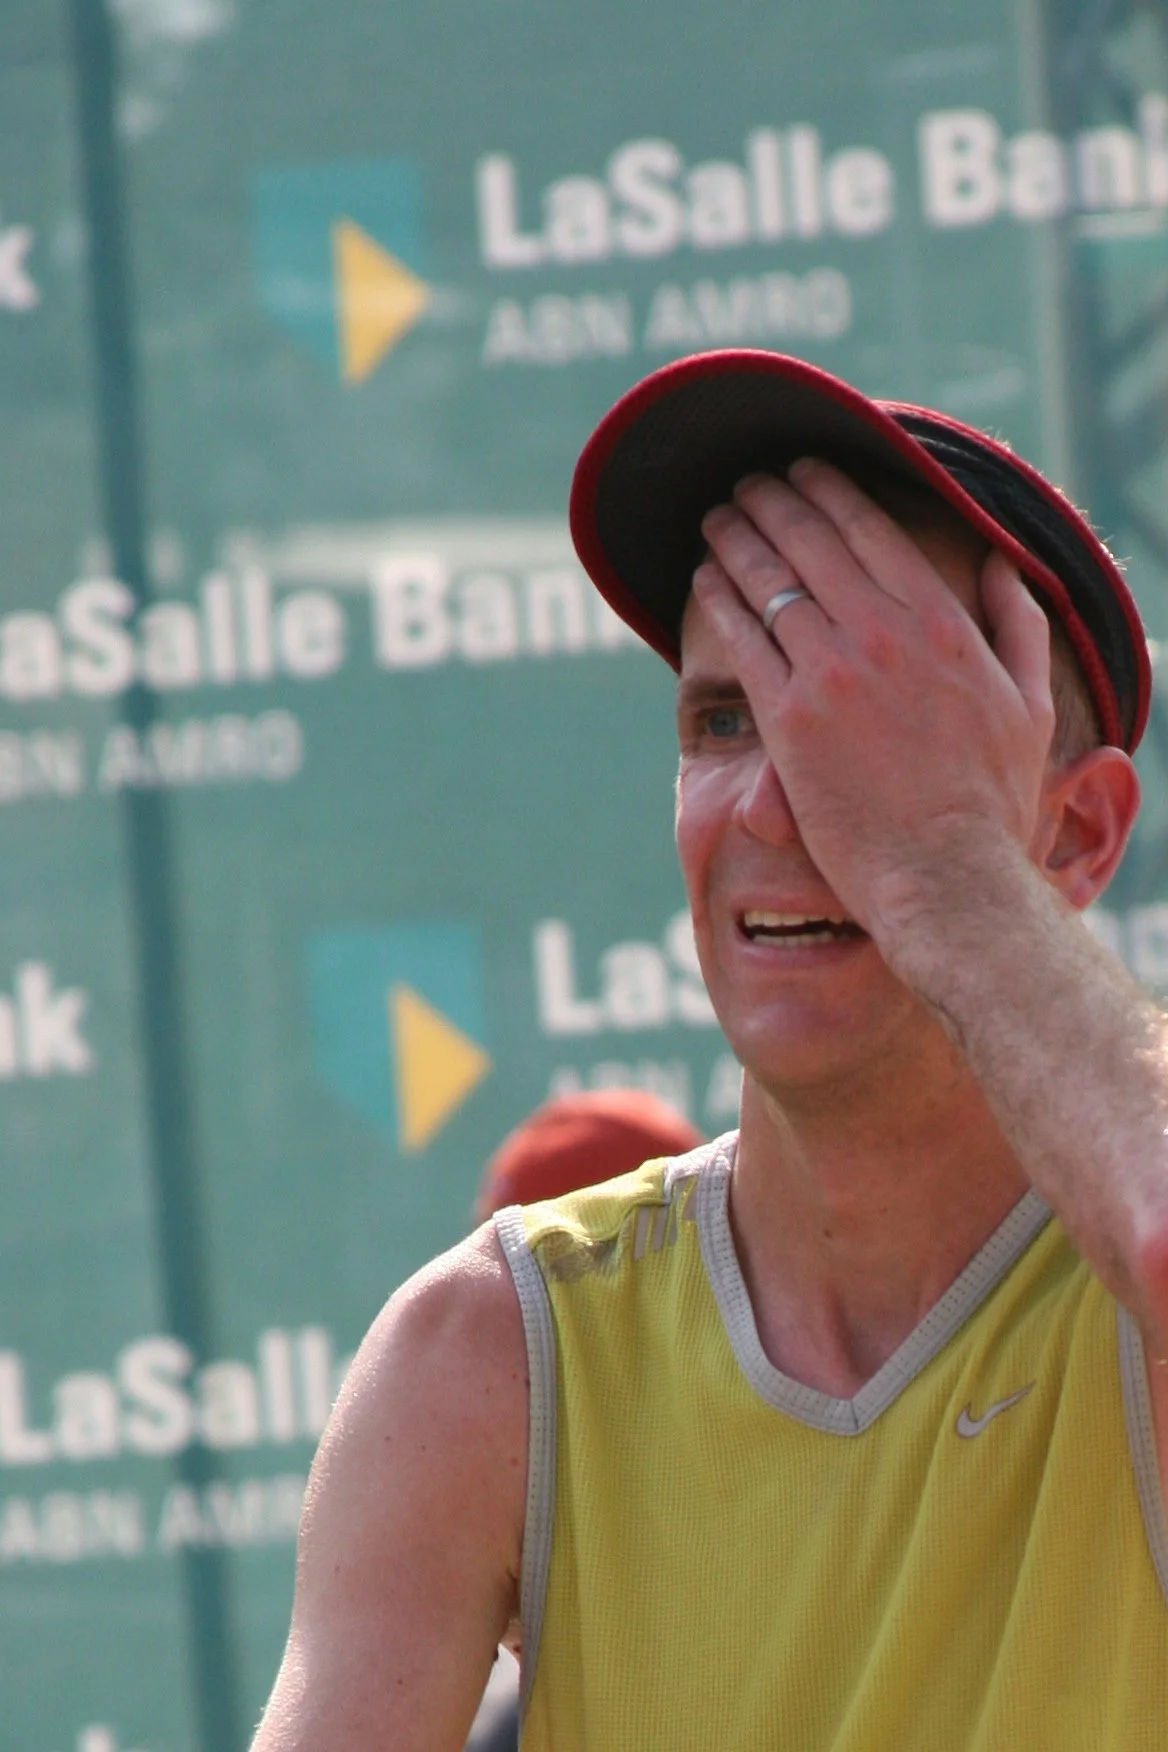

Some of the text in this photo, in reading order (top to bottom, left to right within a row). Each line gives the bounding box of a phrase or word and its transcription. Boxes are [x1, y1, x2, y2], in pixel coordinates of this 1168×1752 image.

[476, 136, 894, 270] LaSalle
[0, 550, 648, 702] aSalle Ban
[0, 1324, 355, 1465] LaSall
